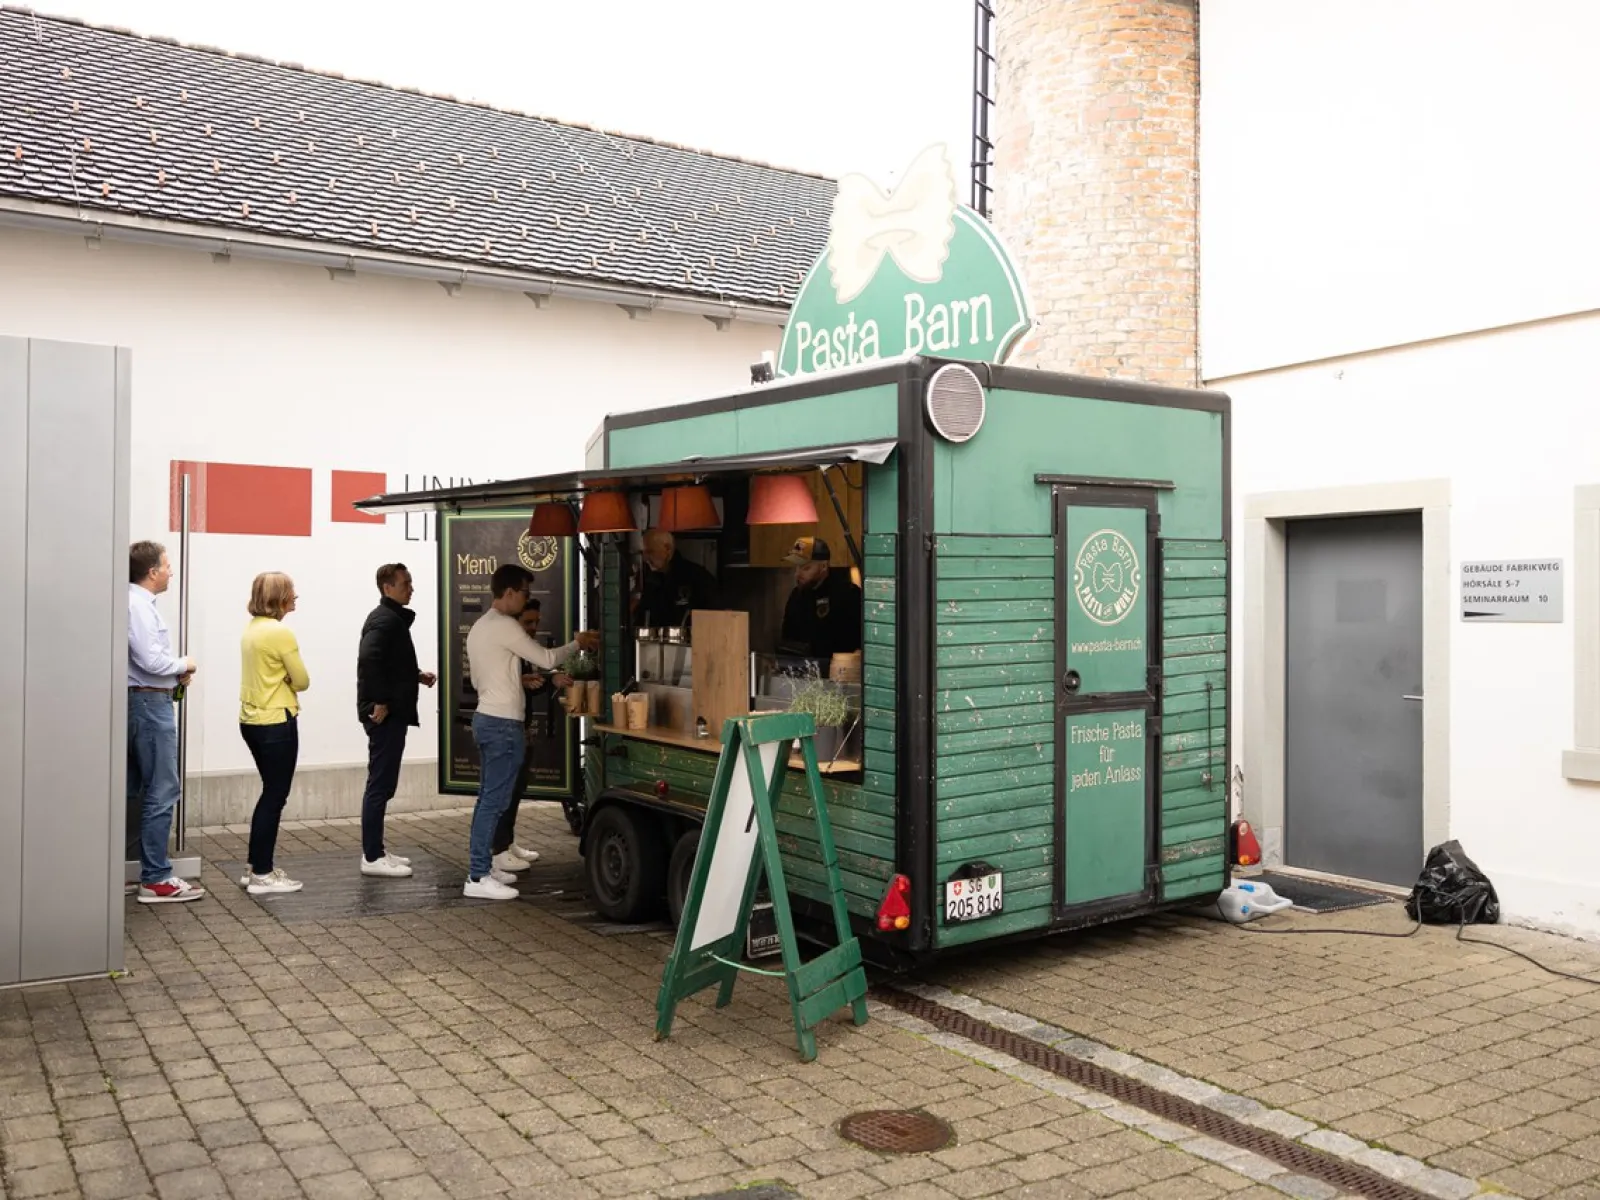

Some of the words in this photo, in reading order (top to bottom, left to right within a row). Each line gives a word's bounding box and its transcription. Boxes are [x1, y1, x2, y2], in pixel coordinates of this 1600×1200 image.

[795, 311, 881, 375] Pasta
[904, 293, 994, 356] Barn
[456, 553, 498, 575] Menü
[1080, 538, 1109, 569] Pasta
[1111, 536, 1133, 570] Barn
[1463, 564, 1504, 573] GEBÄUDE
[1506, 562, 1560, 572] FABRIKWEG
[1463, 578, 1502, 588] HÖRSÄLE
[1505, 579, 1520, 588] 5-7
[1081, 586, 1103, 617] PASTA
[1113, 586, 1134, 616] MORE
[1463, 594, 1530, 603] SEMINARRAUM
[1538, 594, 1549, 603] 10
[1071, 722, 1109, 744] Frische
[1112, 720, 1142, 740] Pasta
[1099, 744, 1116, 763] für
[1070, 768, 1101, 793] jeden
[1104, 764, 1142, 785] Anlass
[968, 877, 983, 894] SG
[949, 897, 974, 919] 205
[977, 891, 1001, 915] 816
